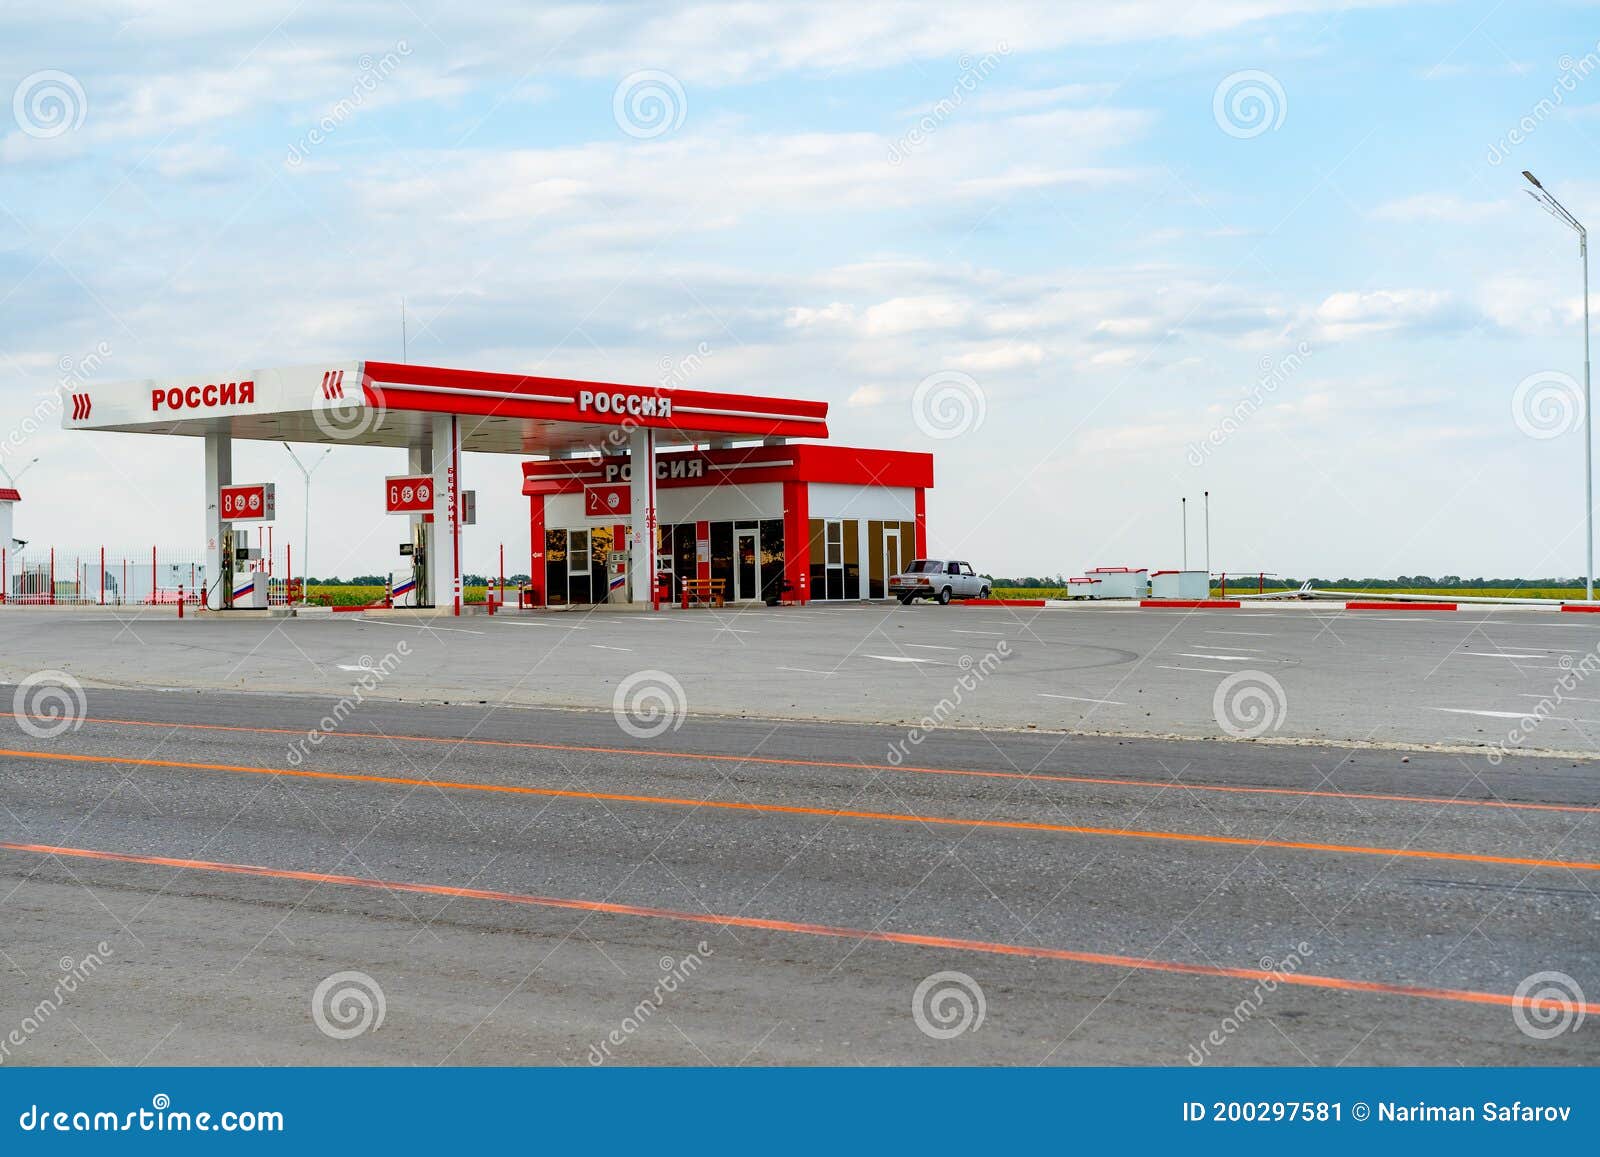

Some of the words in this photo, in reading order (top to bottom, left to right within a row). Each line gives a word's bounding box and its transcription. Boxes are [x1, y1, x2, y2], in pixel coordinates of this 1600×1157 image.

[152, 381, 254, 411] РОССИЯ
[579, 390, 672, 418] РОССИЯ
[605, 459, 703, 483] РОСИЯ
[225, 494, 232, 512] 8
[391, 486, 398, 504] 6
[590, 493, 598, 510] 2
